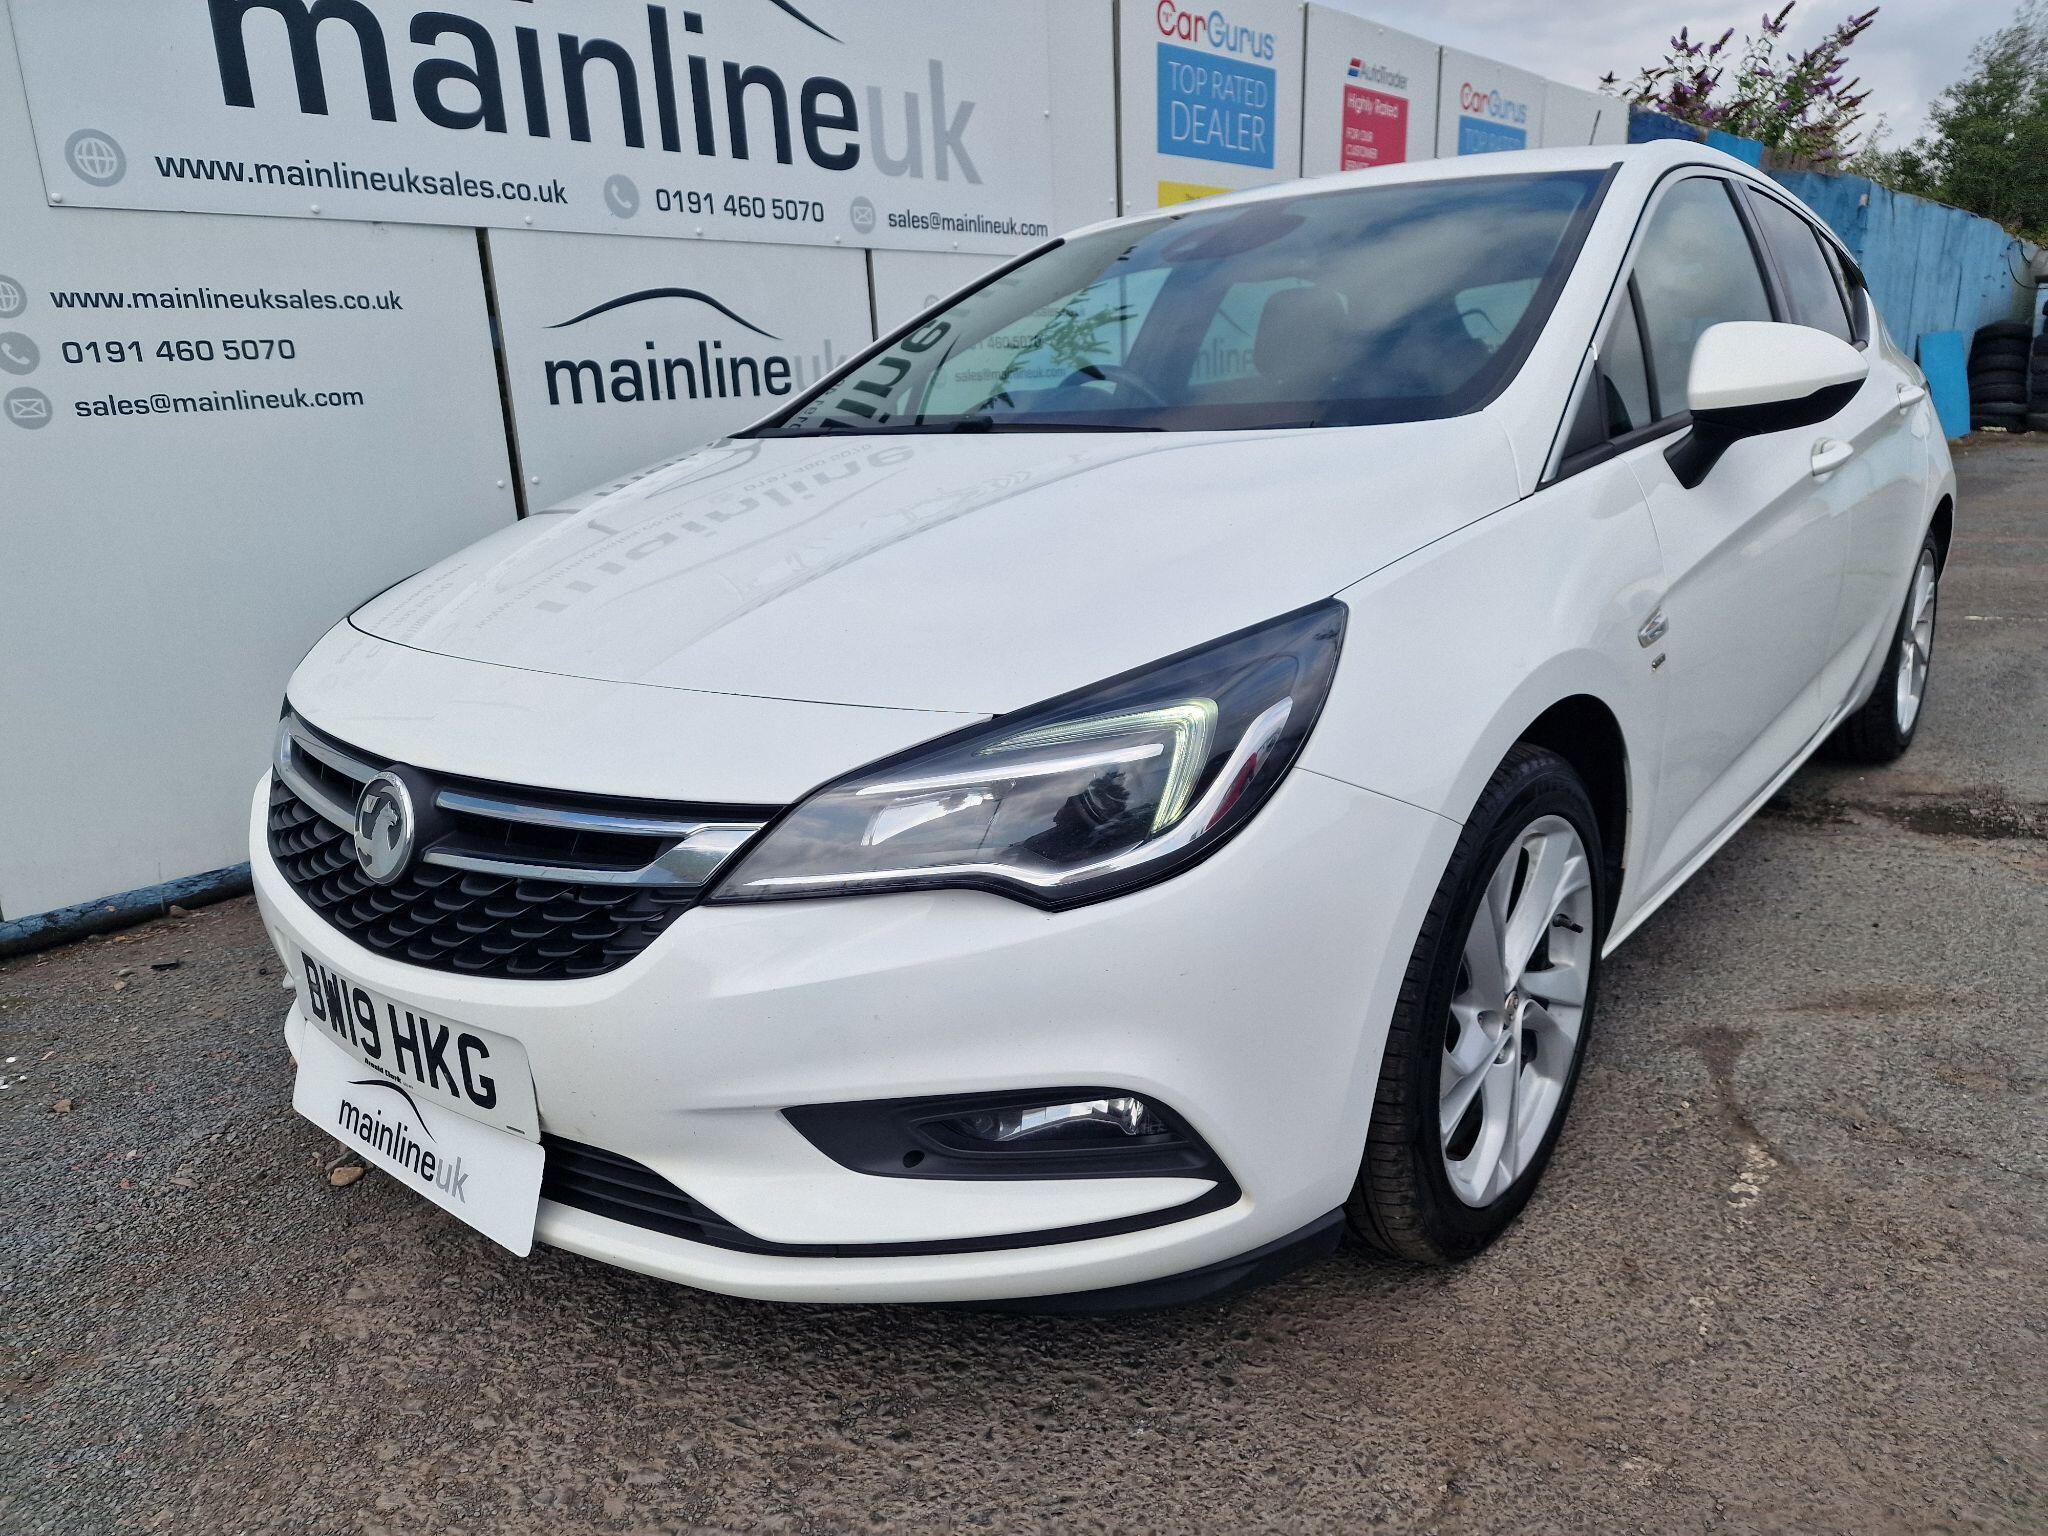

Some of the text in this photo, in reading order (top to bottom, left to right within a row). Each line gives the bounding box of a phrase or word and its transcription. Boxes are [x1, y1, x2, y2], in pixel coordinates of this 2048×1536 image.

[1157, 0, 1274, 61] CarGurus
[208, 0, 983, 185] mainlineuk
[1169, 61, 1268, 109] TOP RATED
[1460, 82, 1527, 124] CarGurus
[1171, 100, 1266, 154] DEALER
[155, 156, 569, 204] www.mainlineuksales.co.uk
[655, 187, 825, 223] 0191 460 5070
[888, 209, 1049, 238] sales@mainlineuk.com
[50, 288, 403, 311] www.mainlineuksales.co.uk
[62, 339, 296, 364] 0191 460 5070
[75, 388, 364, 418] sales@mainlineuk.com
[301, 951, 497, 1110] BW19 HKG
[338, 1099, 470, 1204] mainlineuk
